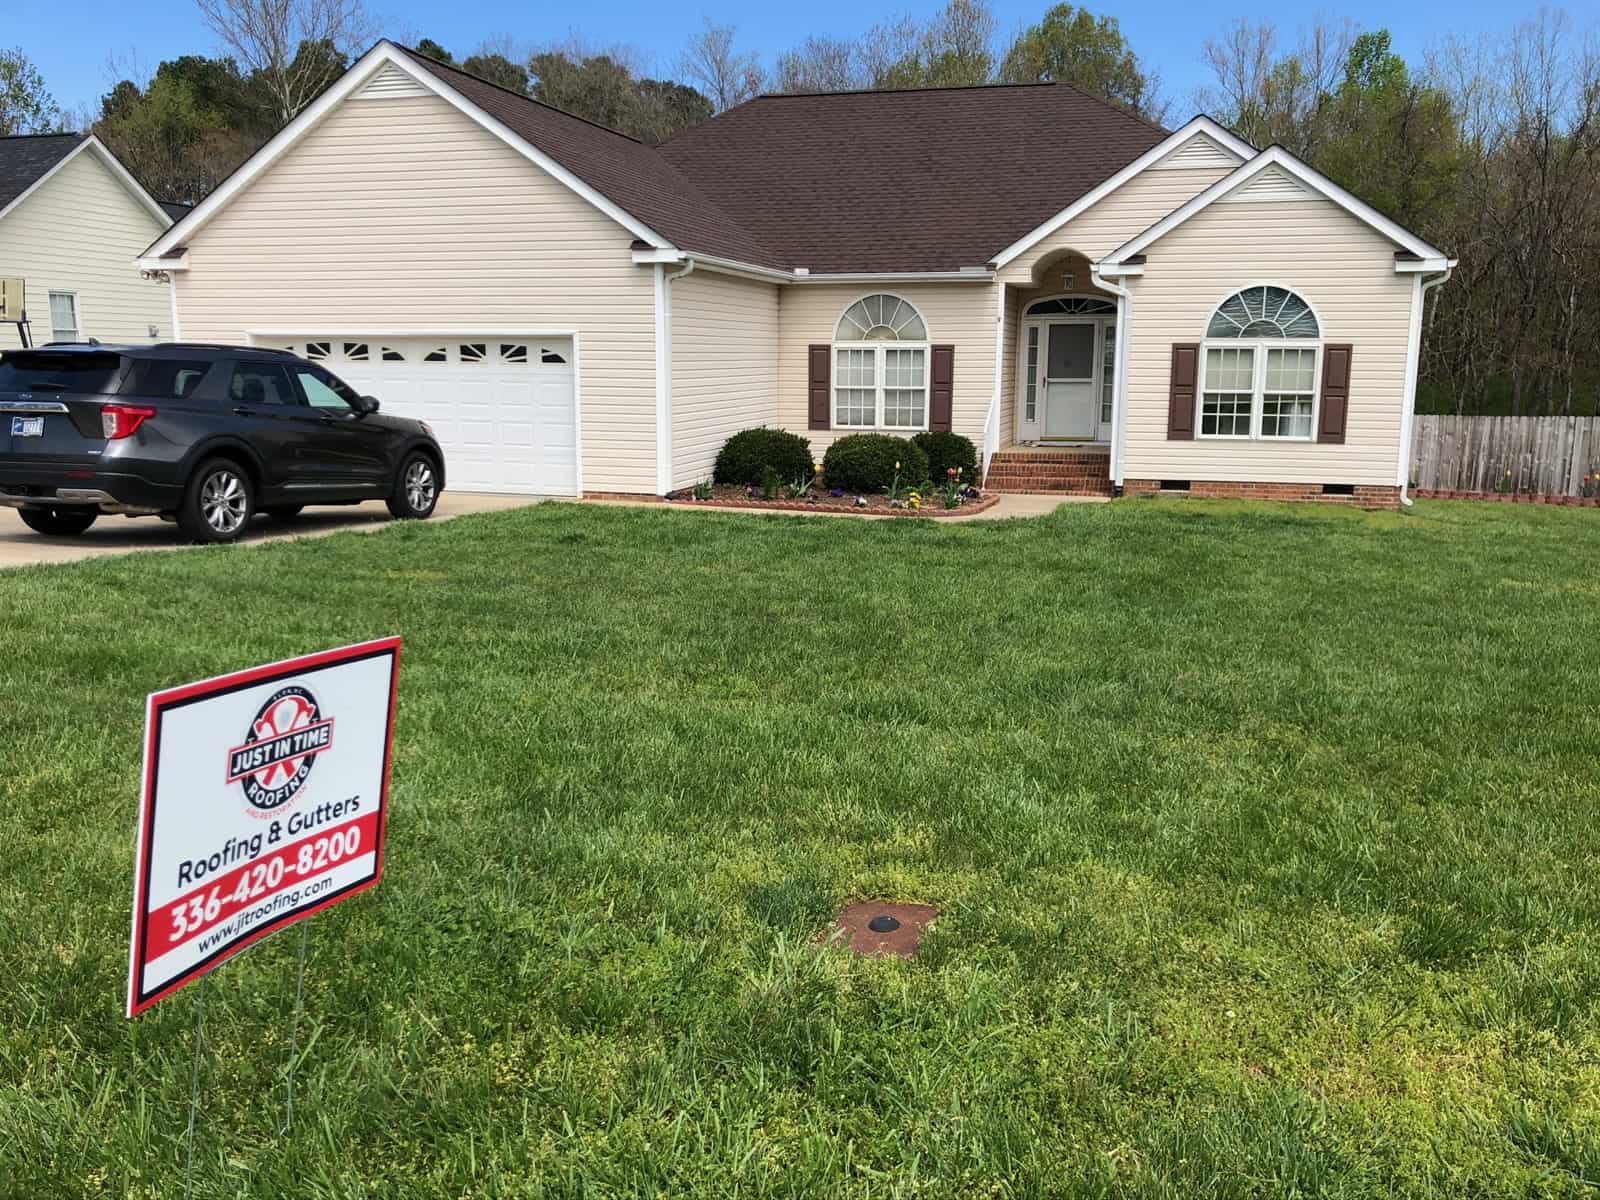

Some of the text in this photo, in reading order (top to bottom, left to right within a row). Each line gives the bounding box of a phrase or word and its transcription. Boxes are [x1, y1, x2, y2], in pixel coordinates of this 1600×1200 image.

[232, 726, 329, 774] JUST IN TIME
[247, 765, 310, 806] ROOFING
[177, 795, 361, 888] Roofing & Gutters
[168, 825, 361, 943] 336-420-8200
[197, 876, 333, 954] www.jitroofing.com
